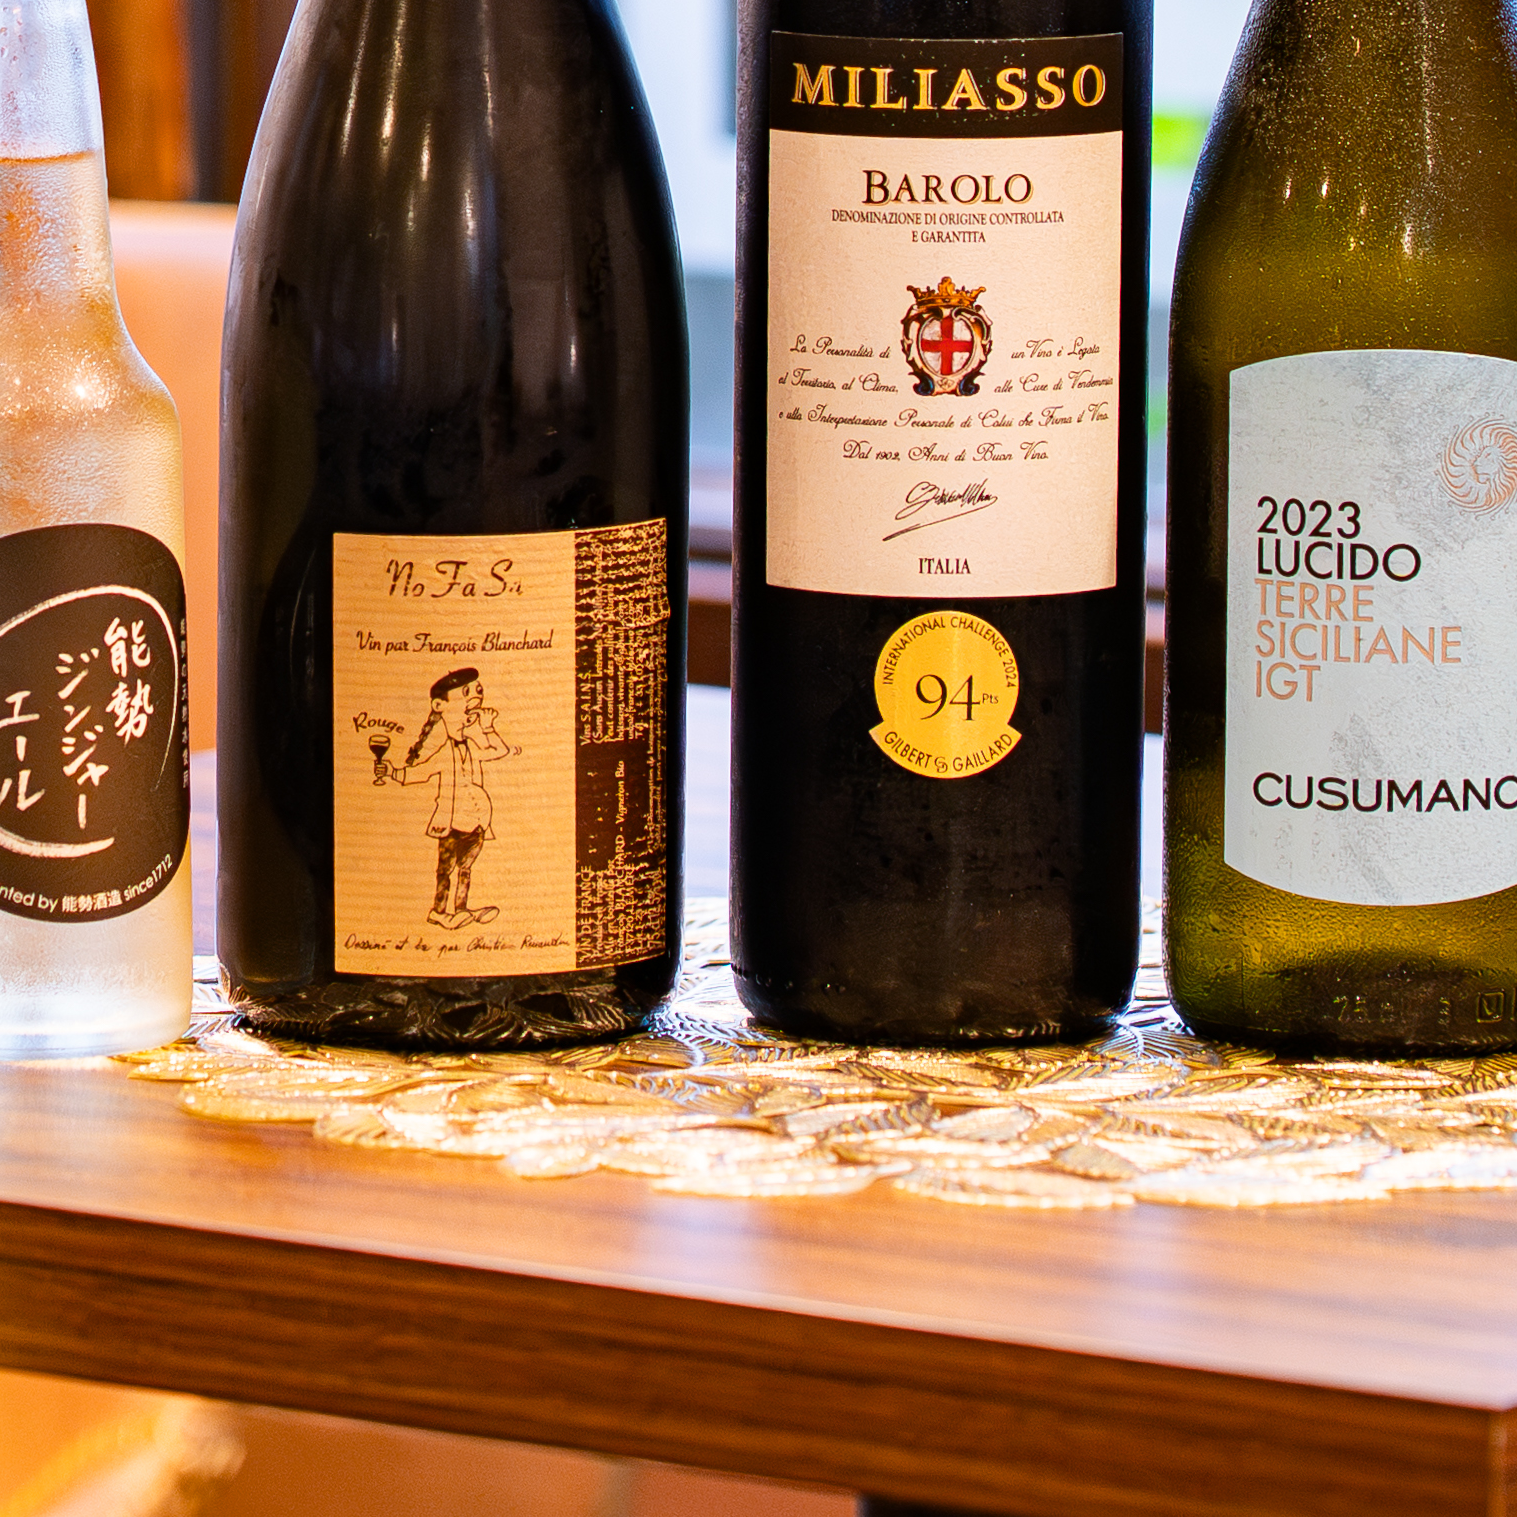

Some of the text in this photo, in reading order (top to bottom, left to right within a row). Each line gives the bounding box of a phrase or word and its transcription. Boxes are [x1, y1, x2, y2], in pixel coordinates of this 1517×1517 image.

[792, 63, 1106, 110] MILIASSO
[862, 170, 1033, 204] BAROLO
[832, 209, 1064, 225] DENOMINAZIONE DI ORIGINE CONTROLLATA
[912, 230, 986, 243] E GARANTITA
[790, 334, 806, 353] La
[879, 346, 891, 358] di
[1011, 351, 1025, 359] un
[1026, 339, 1053, 358] Vino
[842, 378, 855, 390] al
[1053, 378, 1063, 390] di
[960, 414, 972, 428] di
[843, 440, 872, 459] Dal
[954, 449, 966, 461] di
[973, 443, 1013, 461] Buon
[1257, 496, 1361, 539] 2023
[919, 558, 971, 574] ITALIA
[1257, 538, 1421, 582] LUCIDO
[1254, 579, 1374, 622] TERRE
[356, 629, 554, 655] Vin par François Blanchard
[883, 616, 1016, 688] INTERNATIONAL CHALLENGE 2024
[1255, 620, 1462, 664] SICILIANE
[104, 617, 154, 747] 能勢
[1255, 661, 1321, 702] IGT
[916, 674, 999, 721] 94 Pts
[353, 712, 404, 733] Rouge
[55, 648, 109, 829] ジンジャー
[884, 731, 1012, 771] GILBERT GAILLARD
[38, 895, 58, 913] by
[581, 866, 592, 913] FRANCE
[581, 938, 592, 958] VIN
